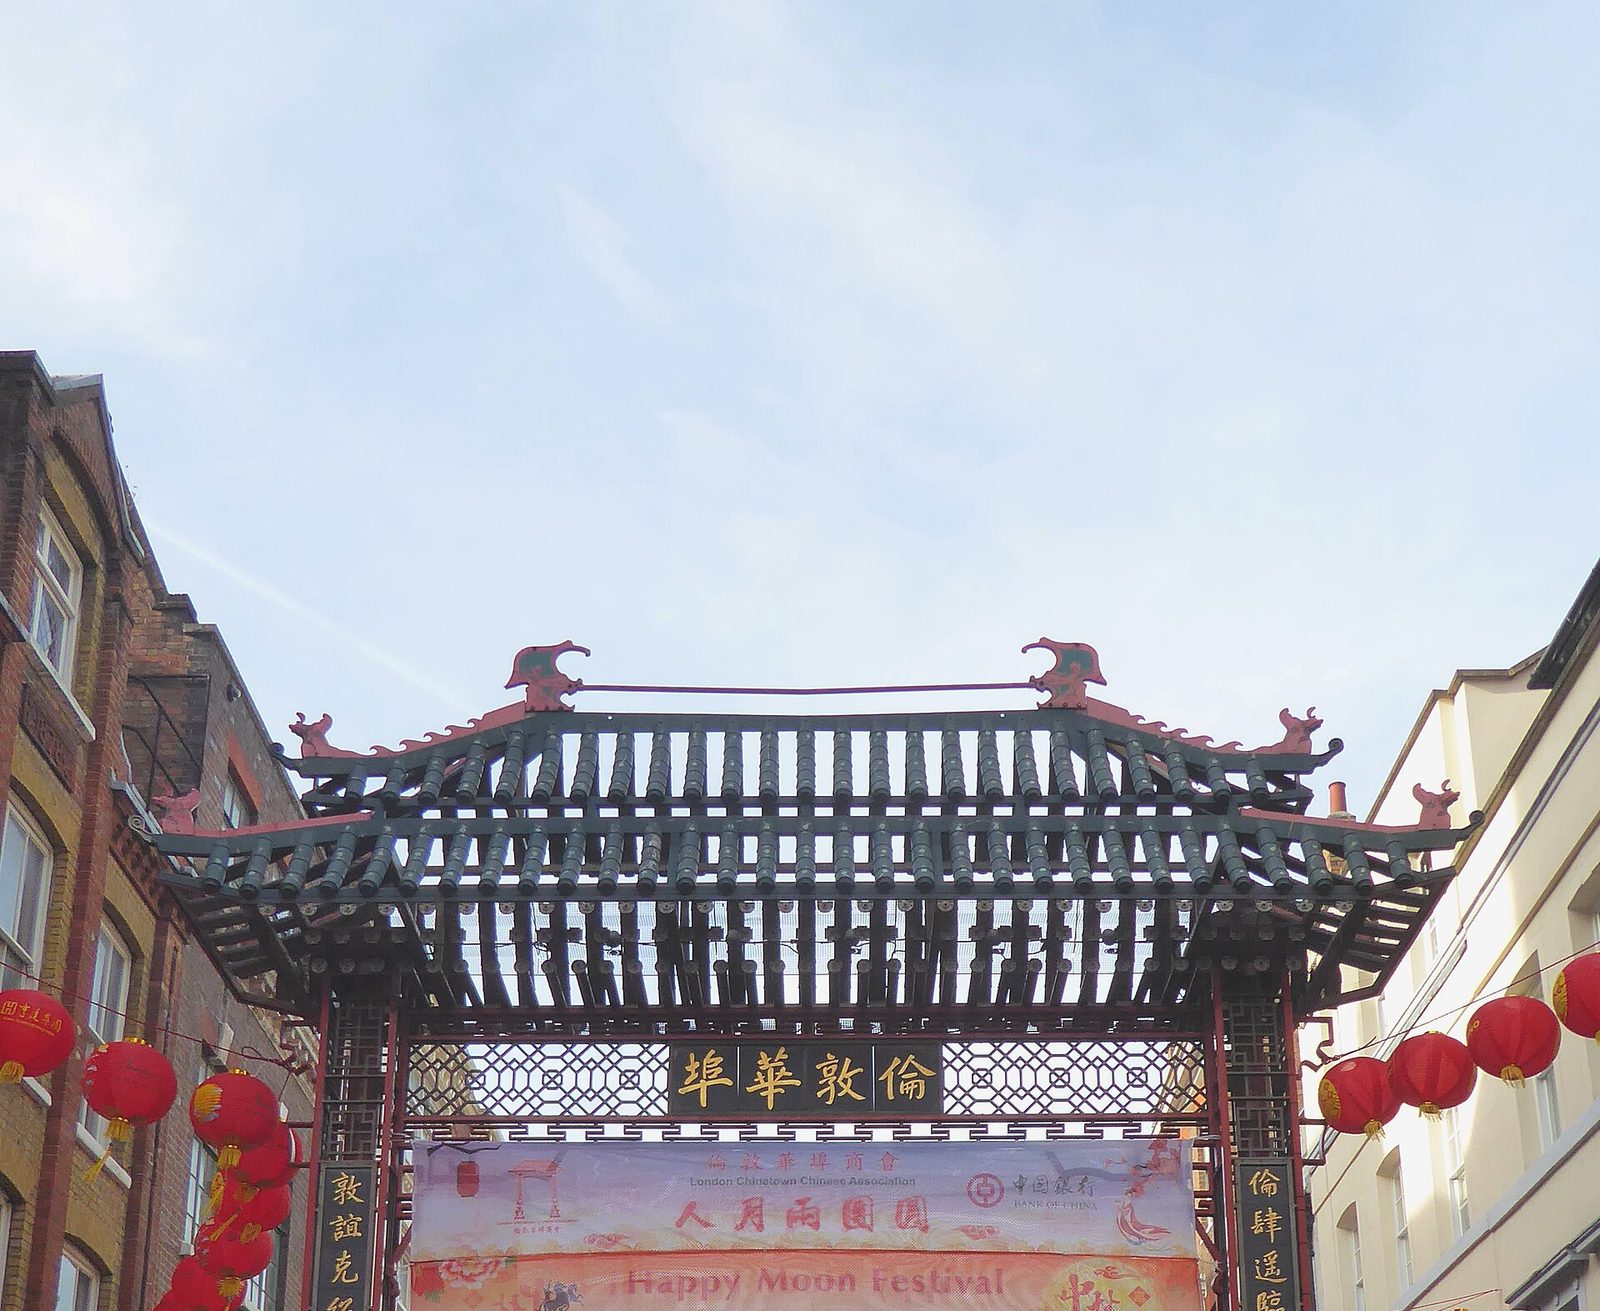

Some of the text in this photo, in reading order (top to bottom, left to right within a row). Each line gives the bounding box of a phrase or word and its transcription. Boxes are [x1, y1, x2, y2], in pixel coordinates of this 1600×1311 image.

[707, 1151, 901, 1172] 倫敦華埠商會
[690, 1176, 916, 1187] London Chinatown Chinese Association
[1014, 1200, 1042, 1209] BANK
[1063, 1201, 1098, 1210] CHINA
[627, 1267, 1004, 1301] Happy Moon Festival
